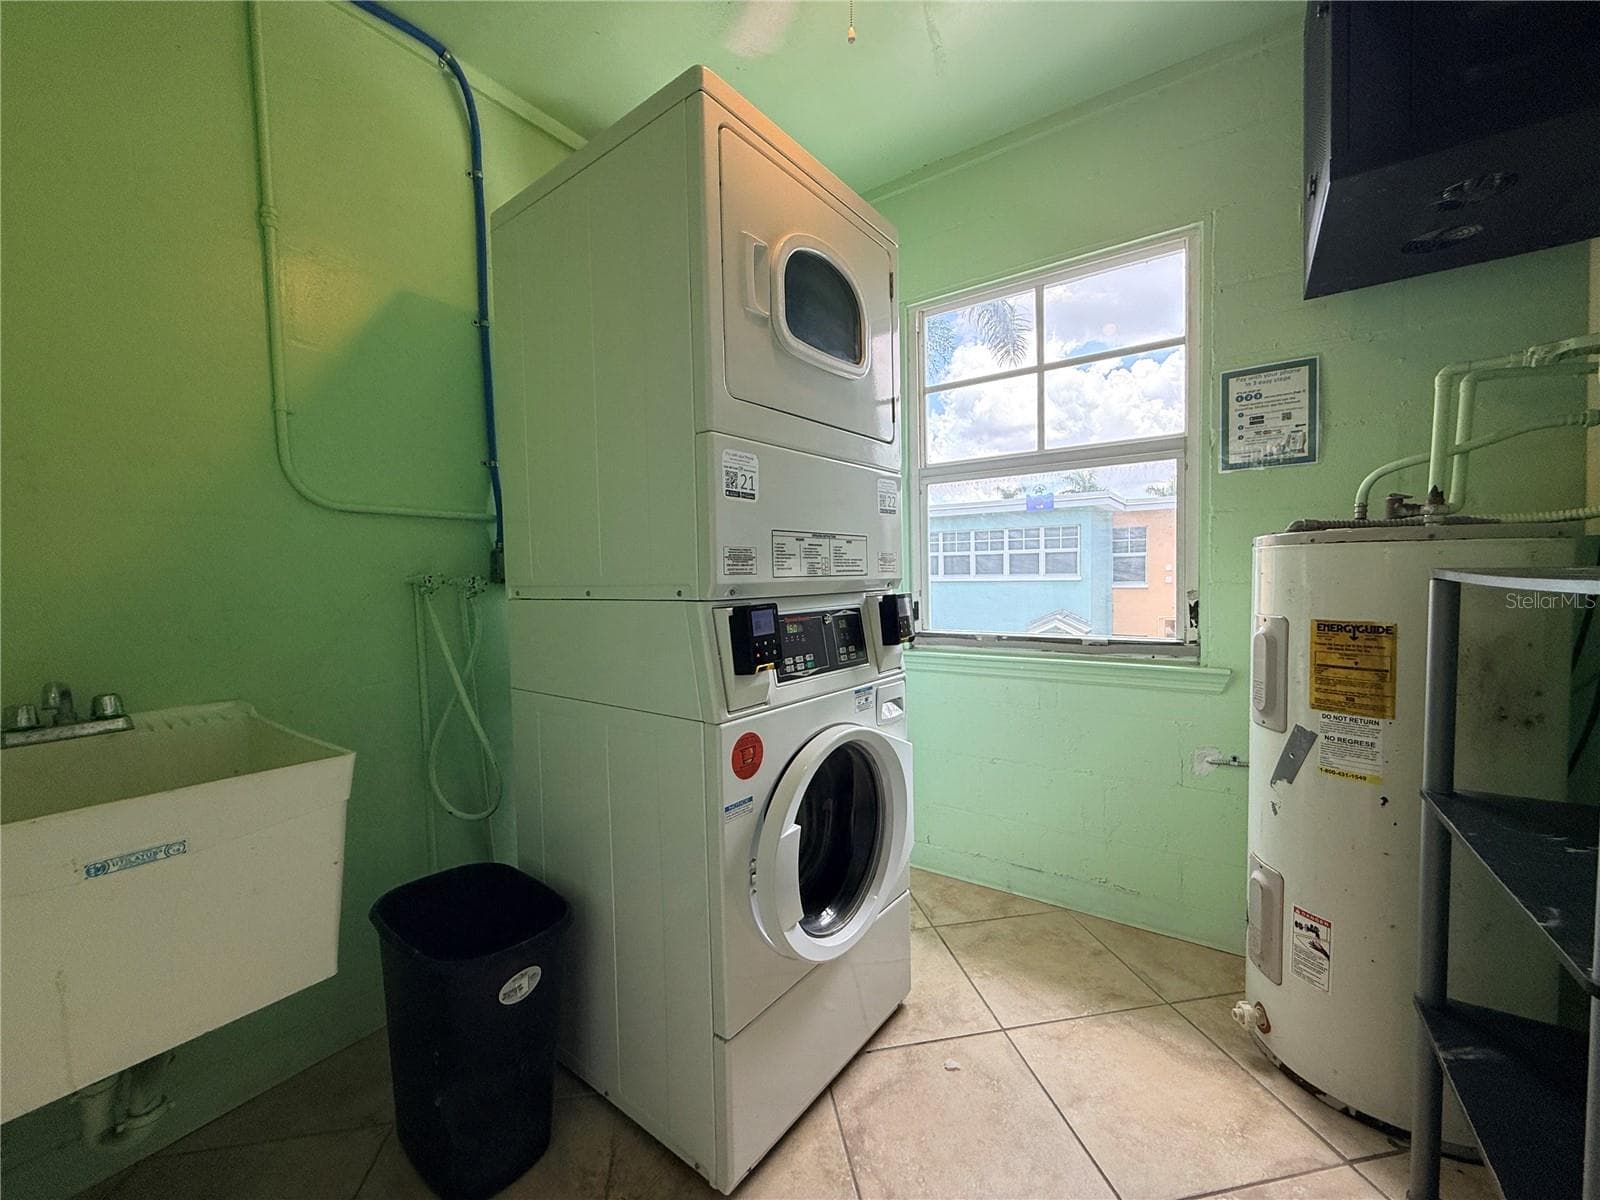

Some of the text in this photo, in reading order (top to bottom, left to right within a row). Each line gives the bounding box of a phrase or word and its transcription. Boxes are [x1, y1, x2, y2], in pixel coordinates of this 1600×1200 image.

[740, 473, 756, 491] 21
[1316, 623, 1394, 635] ENERGYGUIDE
[1349, 717, 1380, 726] RETURN
[1337, 737, 1376, 749] REGRESE
